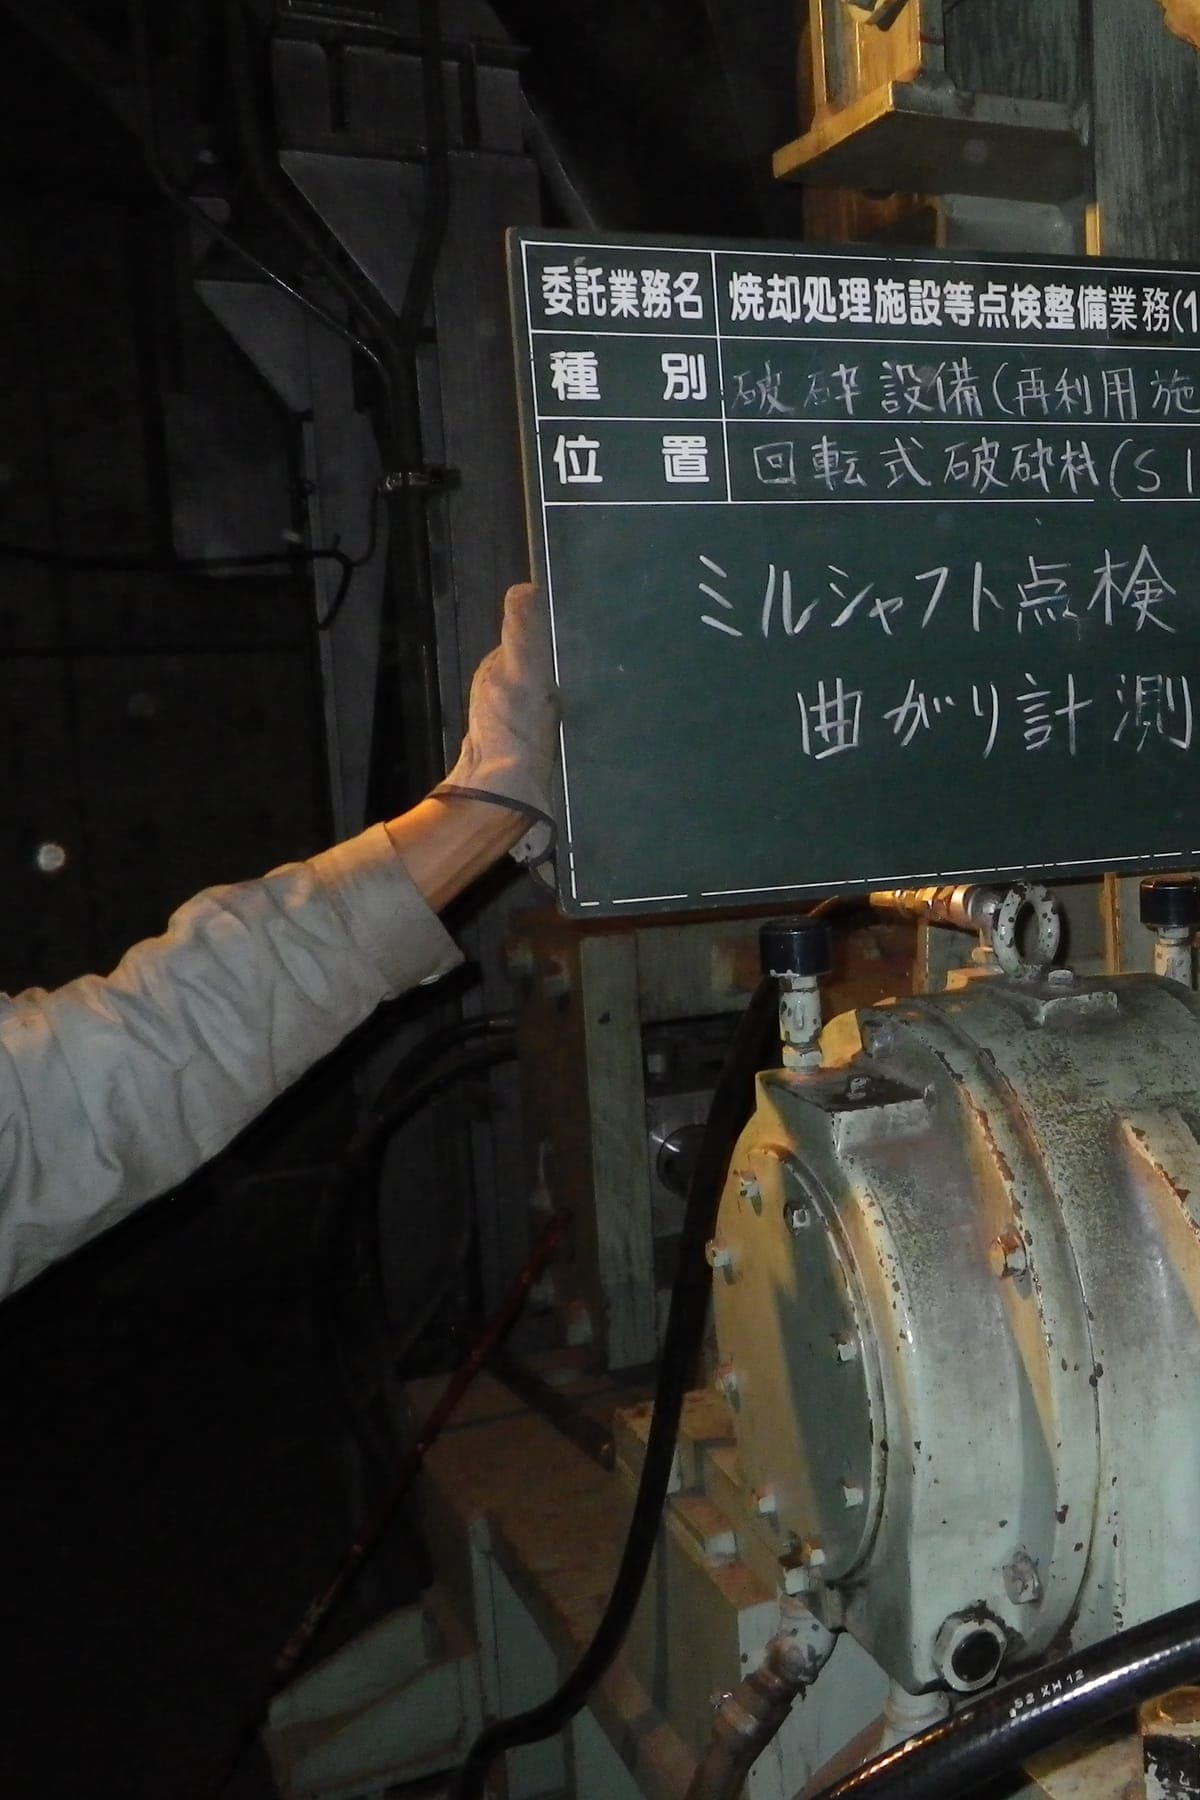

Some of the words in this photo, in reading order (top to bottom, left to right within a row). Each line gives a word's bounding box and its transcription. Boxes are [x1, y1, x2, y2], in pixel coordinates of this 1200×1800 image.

[541, 264, 703, 320] 委託業務名
[549, 350, 708, 401] 種別
[552, 433, 710, 485] 位置
[698, 544, 1177, 638] ミルシャフト点検
[797, 672, 1194, 760] 曲がり計測
